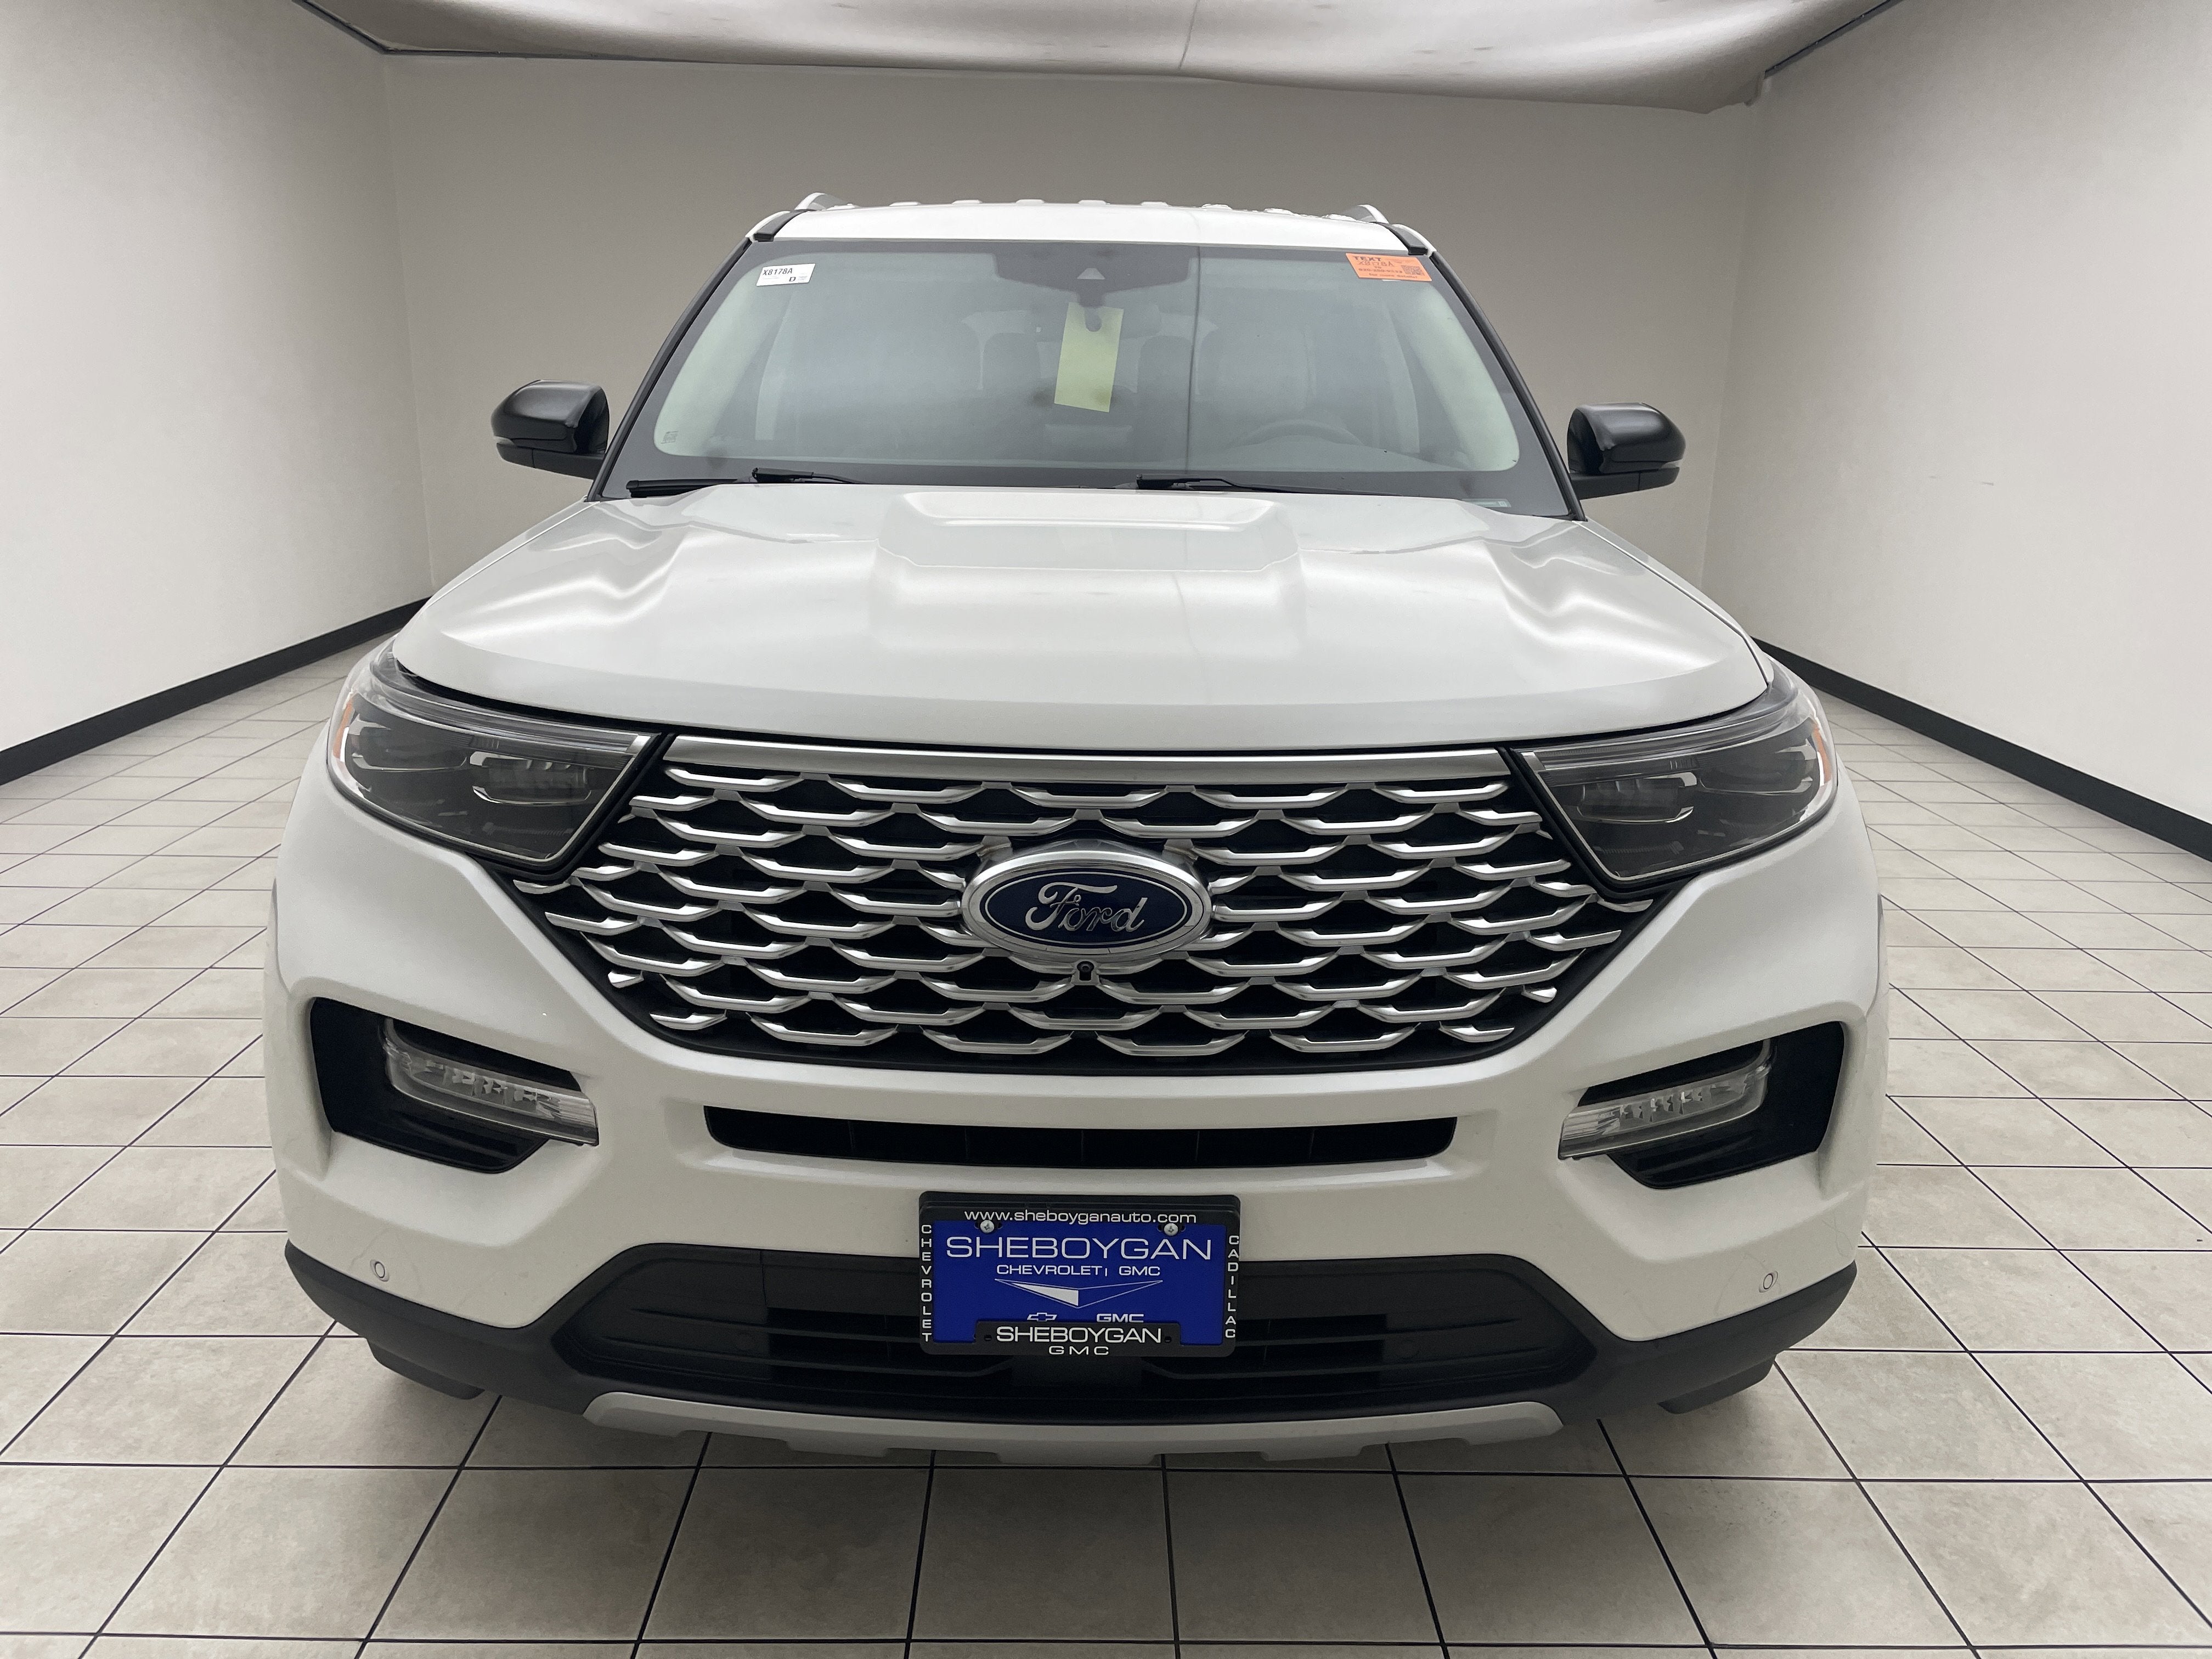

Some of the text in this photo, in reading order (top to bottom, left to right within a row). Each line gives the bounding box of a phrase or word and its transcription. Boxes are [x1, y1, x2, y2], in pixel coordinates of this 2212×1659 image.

[1025, 881, 1148, 932] Ford
[964, 1209, 1197, 1224] www.sheboyganauto.com
[946, 1236, 1211, 1260] SHEBOYGAN
[996, 1264, 1161, 1276] CHEVROLET GMC
[921, 1224, 932, 1342] CHEVROLET
[1225, 1235, 1240, 1339] CADILLAC
[1096, 1313, 1144, 1323] GMC
[996, 1326, 1161, 1344] SHEBOYGAN
[1048, 1345, 1109, 1356] GMC
